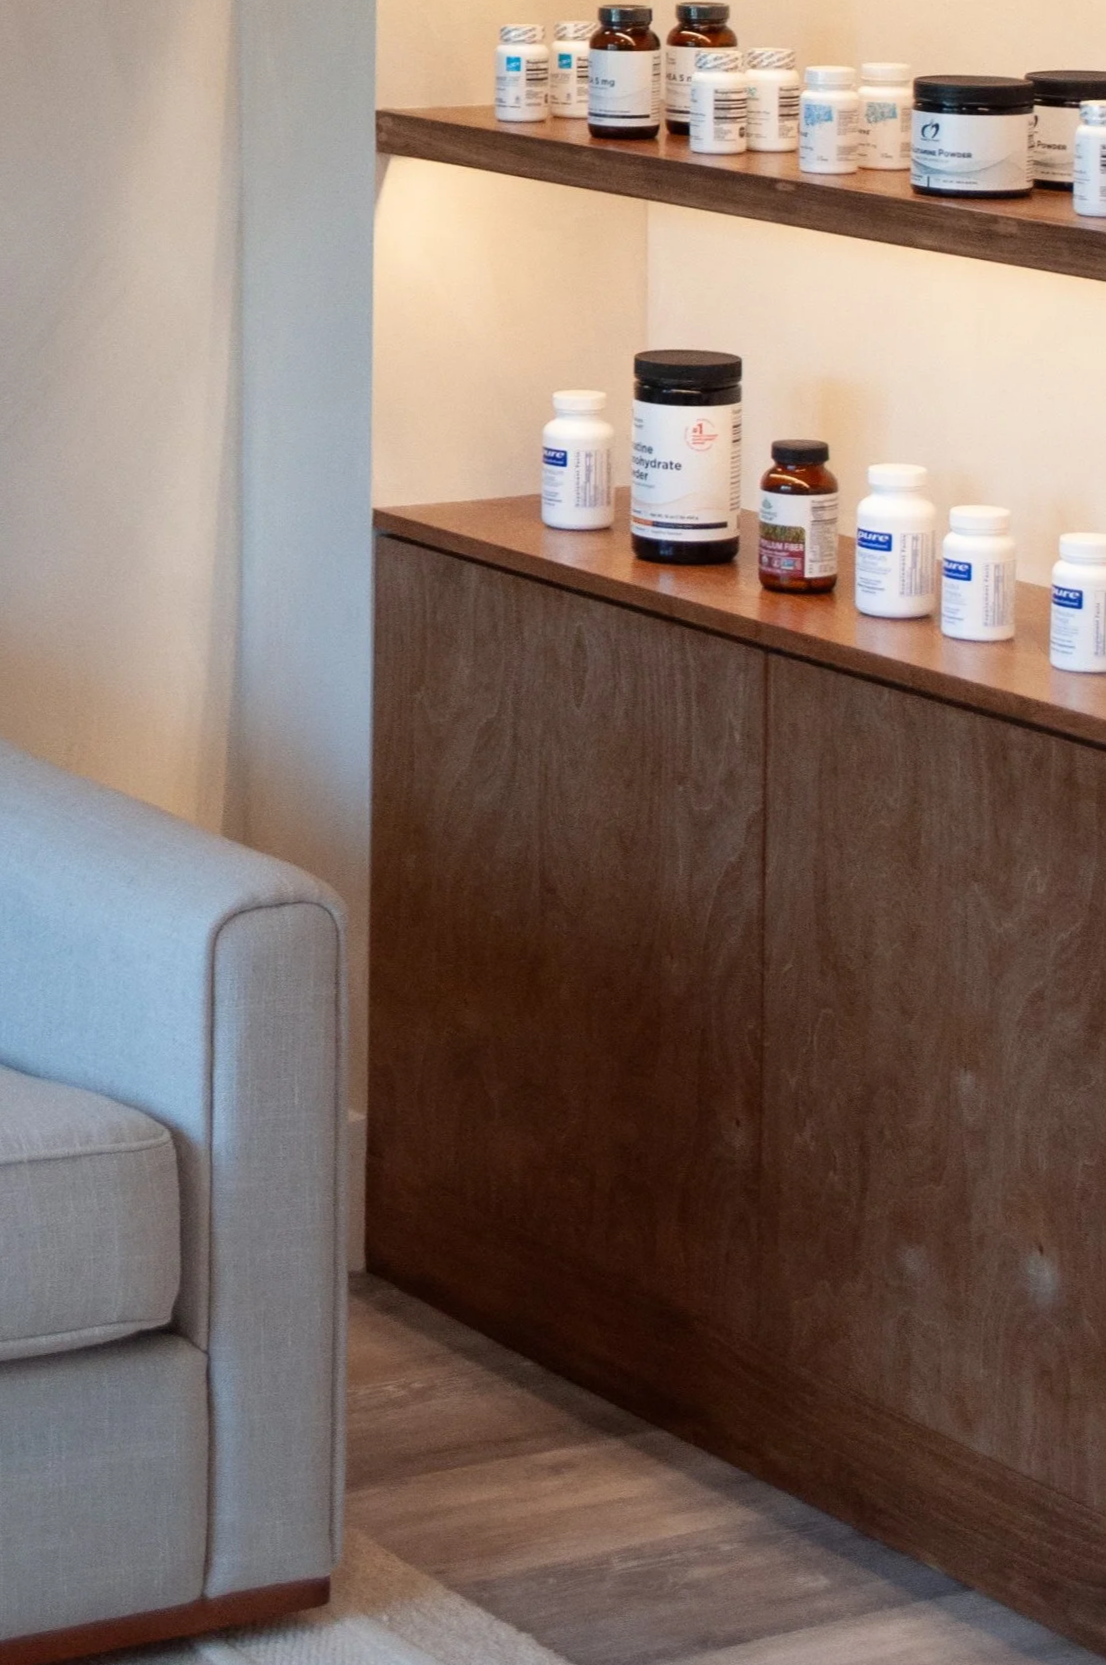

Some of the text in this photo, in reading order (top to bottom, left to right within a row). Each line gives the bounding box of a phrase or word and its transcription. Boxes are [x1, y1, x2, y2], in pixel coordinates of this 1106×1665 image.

[595, 77, 600, 85] 5
[601, 78, 615, 87] mg
[1037, 142, 1067, 151] POWDER
[937, 150, 973, 159] POWDER
[858, 530, 889, 542] pure
